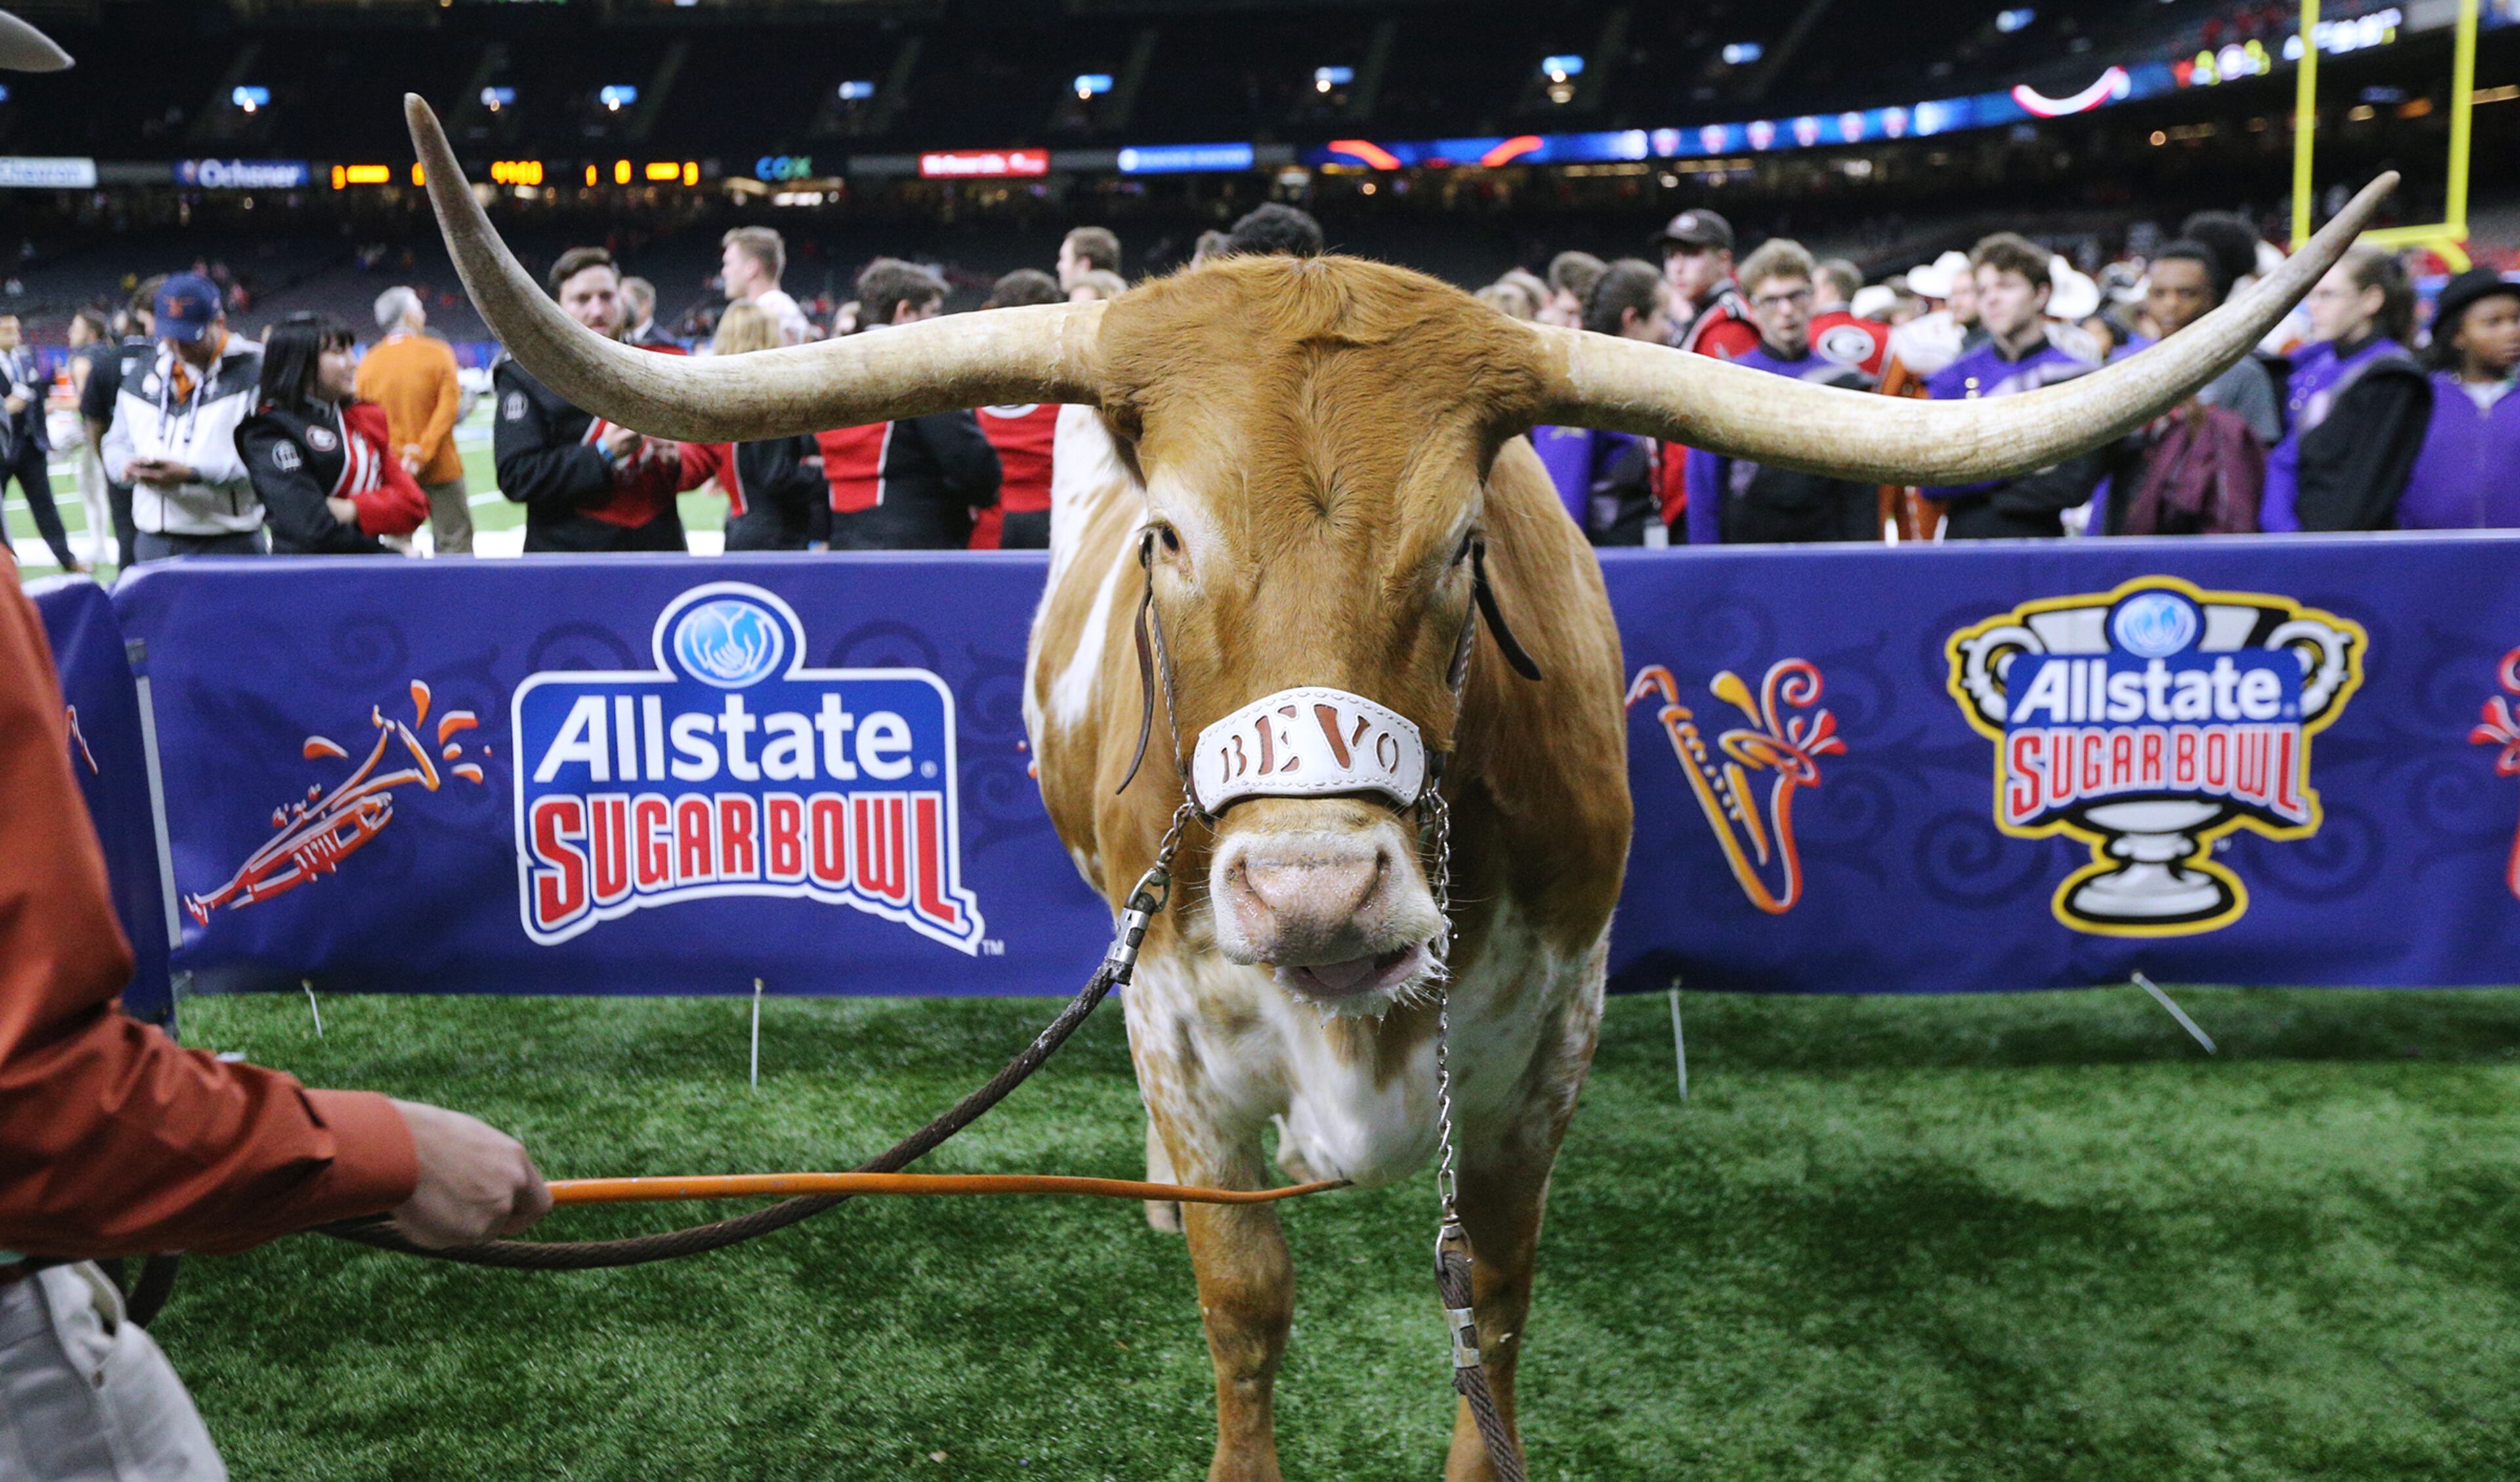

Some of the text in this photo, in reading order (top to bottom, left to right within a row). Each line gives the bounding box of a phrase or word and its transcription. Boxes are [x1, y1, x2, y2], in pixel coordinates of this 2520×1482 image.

[755, 155, 812, 182] COX
[2011, 657, 2283, 722] Allstate
[534, 693, 914, 783] Allstate
[1221, 704, 1399, 784] BEVO
[2008, 725, 2306, 823] SUGAR BOWL
[530, 792, 966, 933] SUGAR BOWL
[982, 939, 1005, 956] TM
